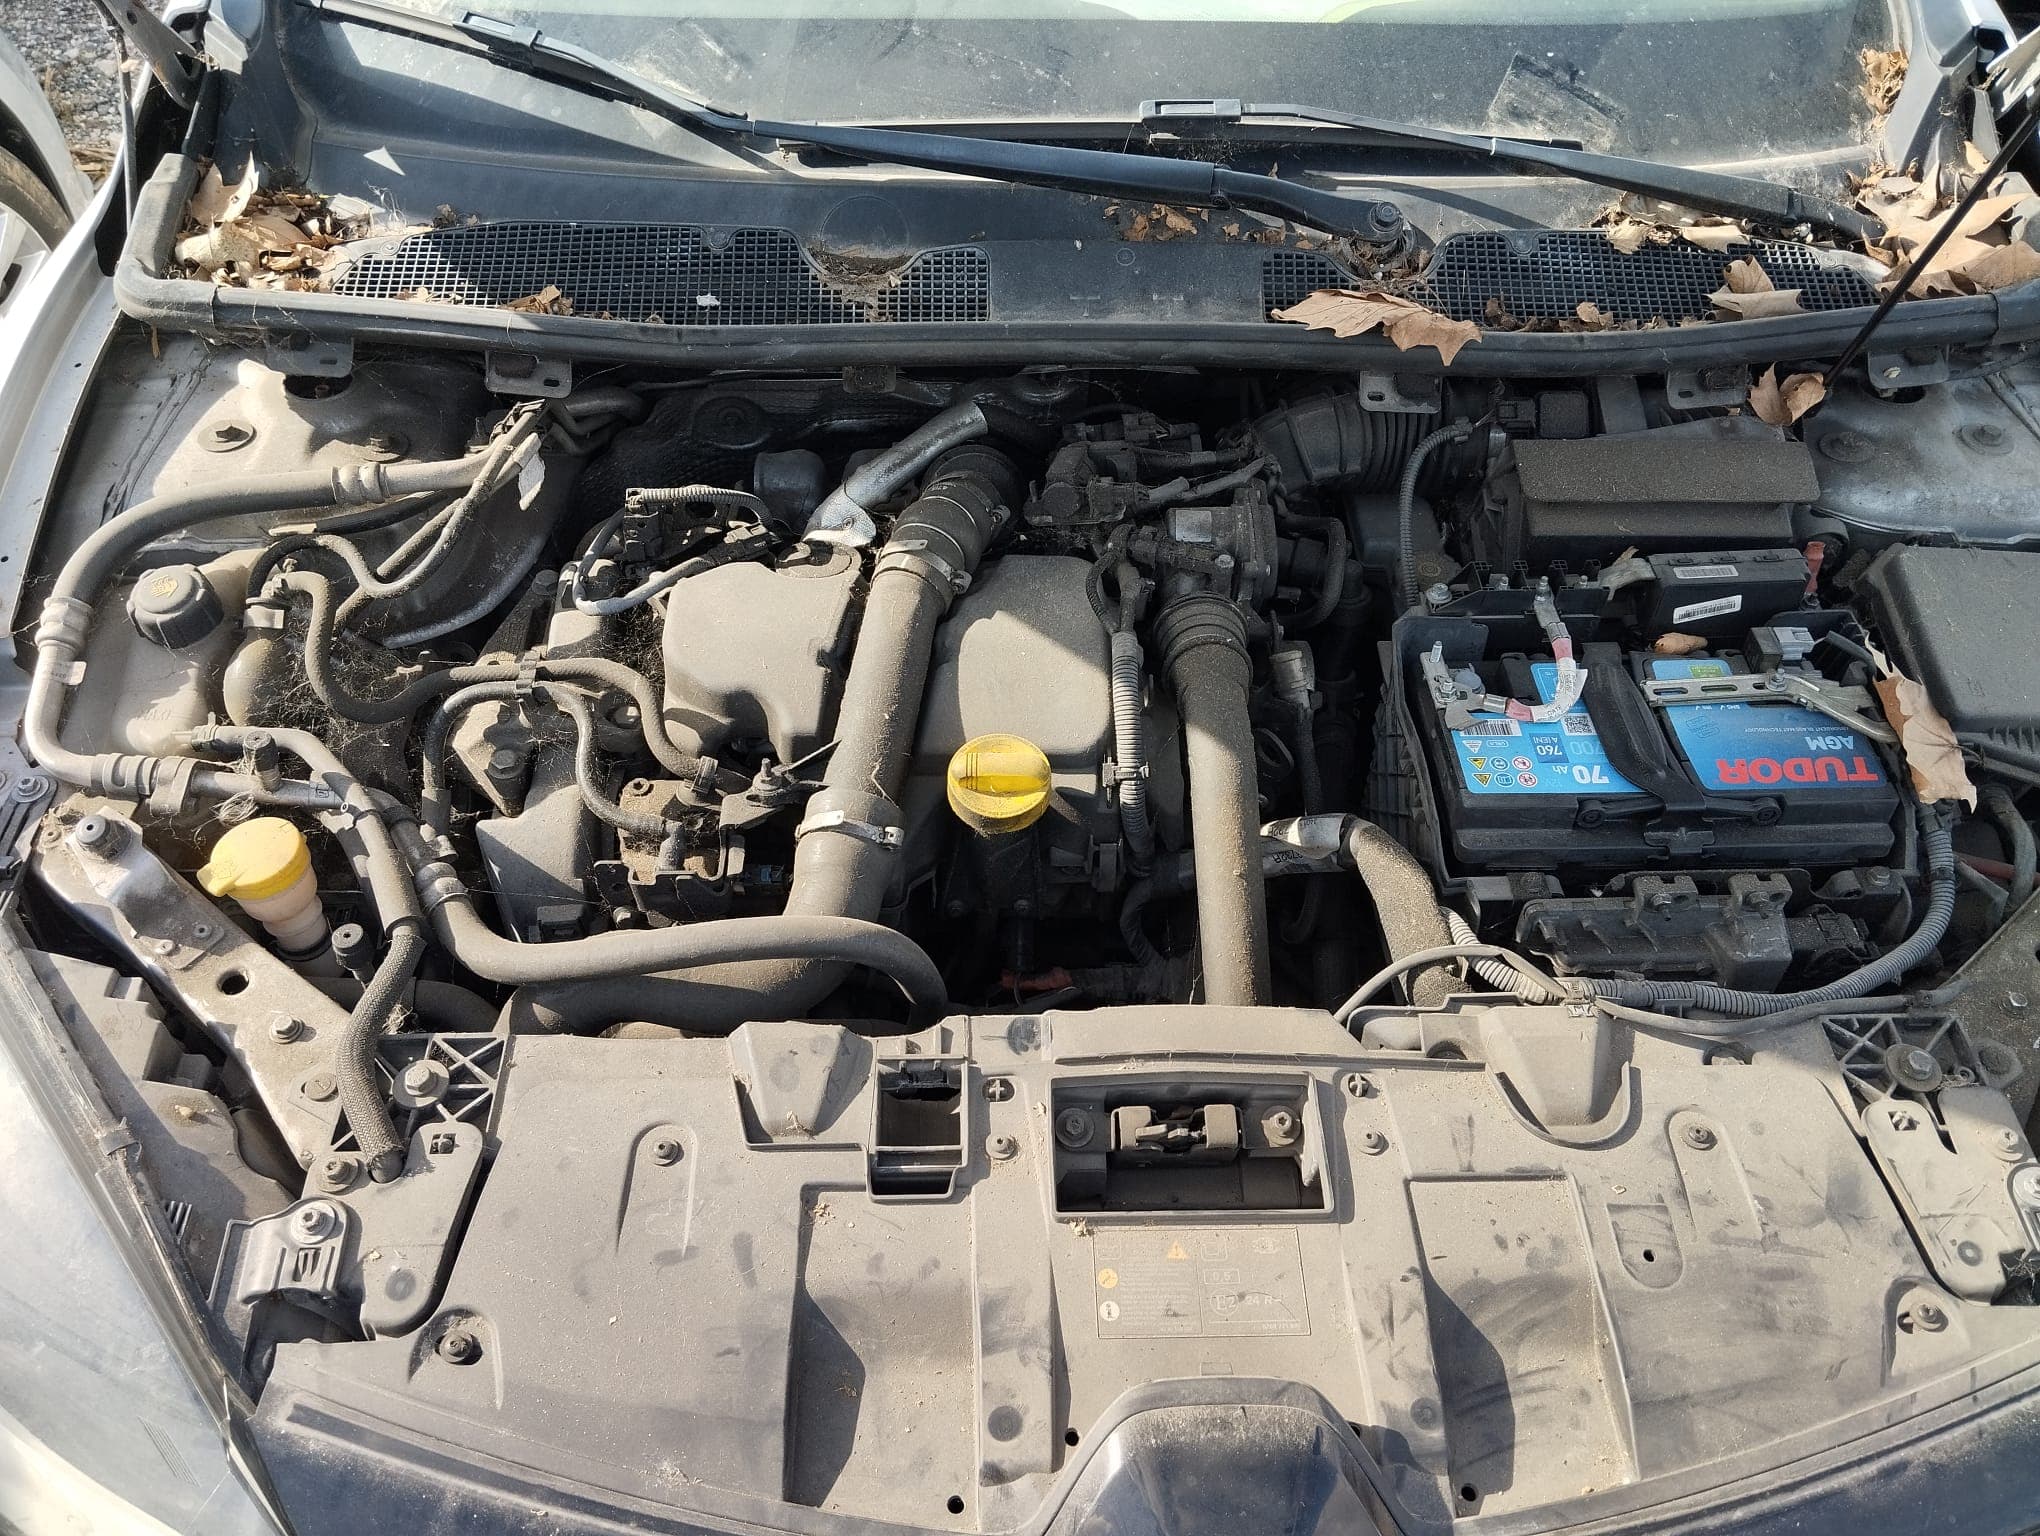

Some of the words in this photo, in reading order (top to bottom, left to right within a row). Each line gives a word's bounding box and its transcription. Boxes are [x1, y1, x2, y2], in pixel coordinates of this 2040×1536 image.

[1537, 745, 1563, 756] 760
[1807, 735, 1854, 751] AGM
[1552, 765, 1568, 774] Ah
[1573, 765, 1609, 784] 70
[1717, 757, 1879, 784] TUDOR
